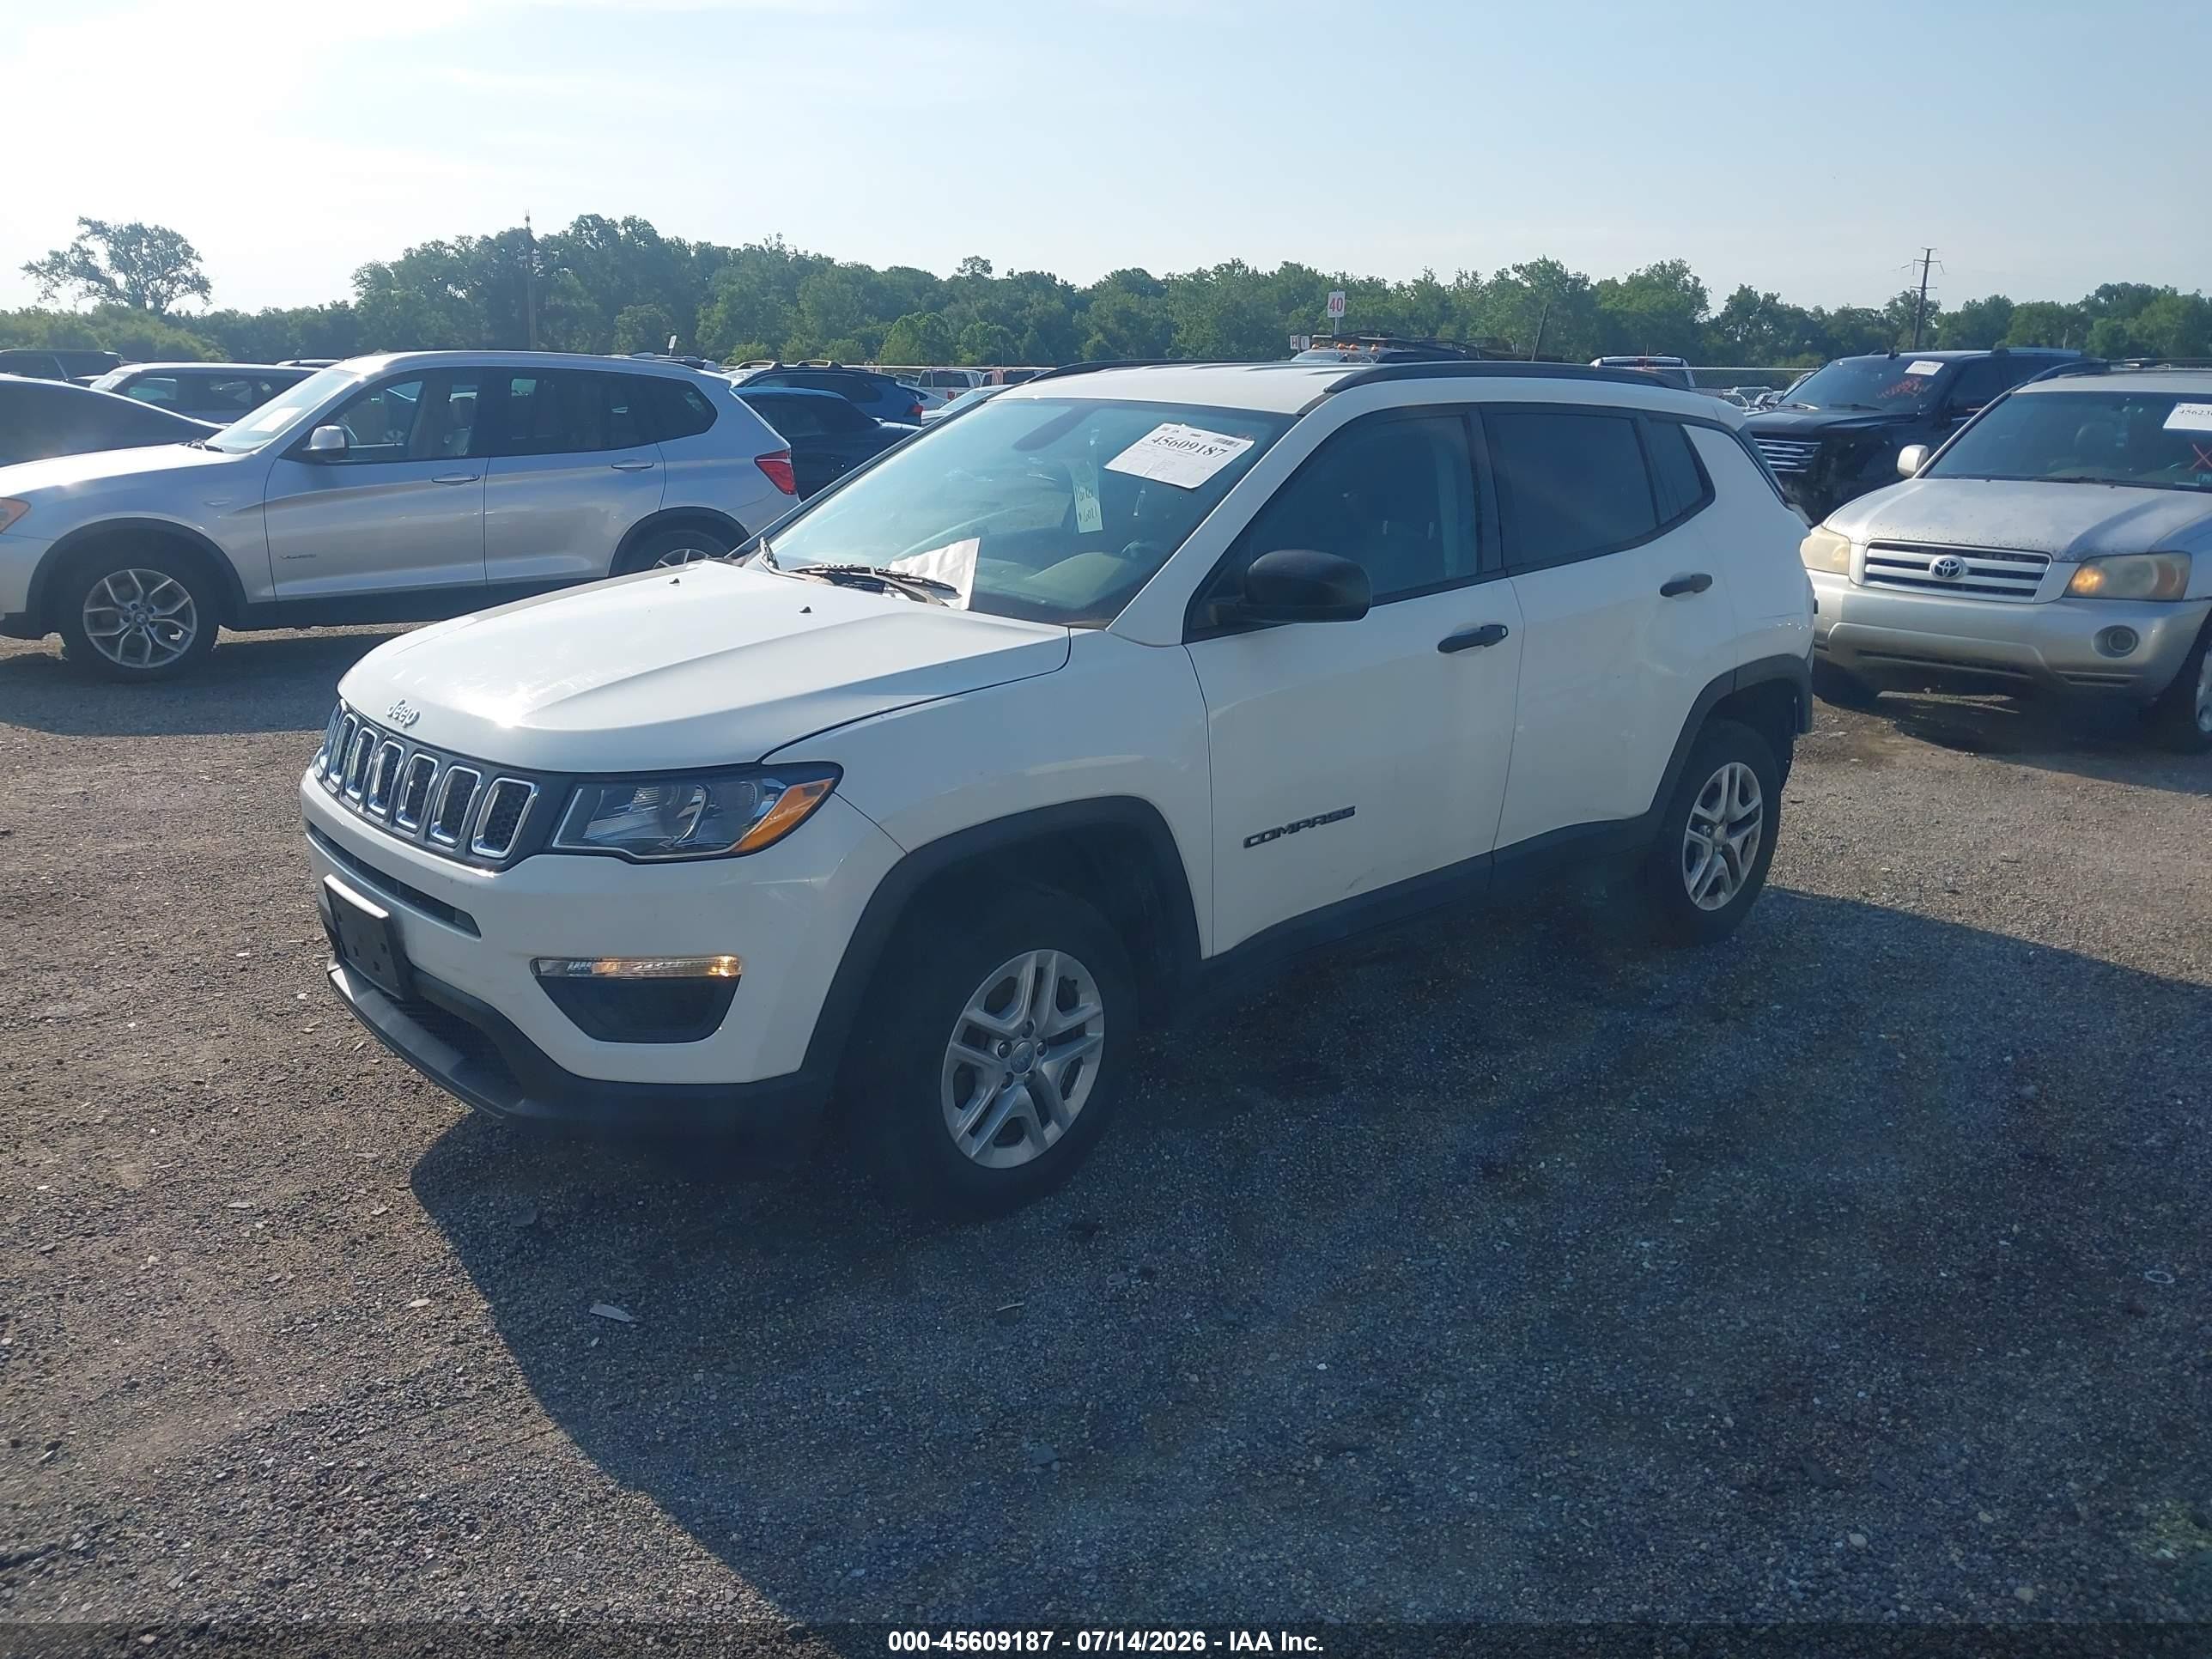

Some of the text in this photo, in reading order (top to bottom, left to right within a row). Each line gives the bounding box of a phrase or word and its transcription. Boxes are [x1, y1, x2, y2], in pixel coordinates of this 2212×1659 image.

[1329, 298, 1344, 313] 40
[1152, 435, 1229, 459] 45609187
[386, 699, 421, 728] Jeep
[1243, 805, 1356, 848] COMPASS
